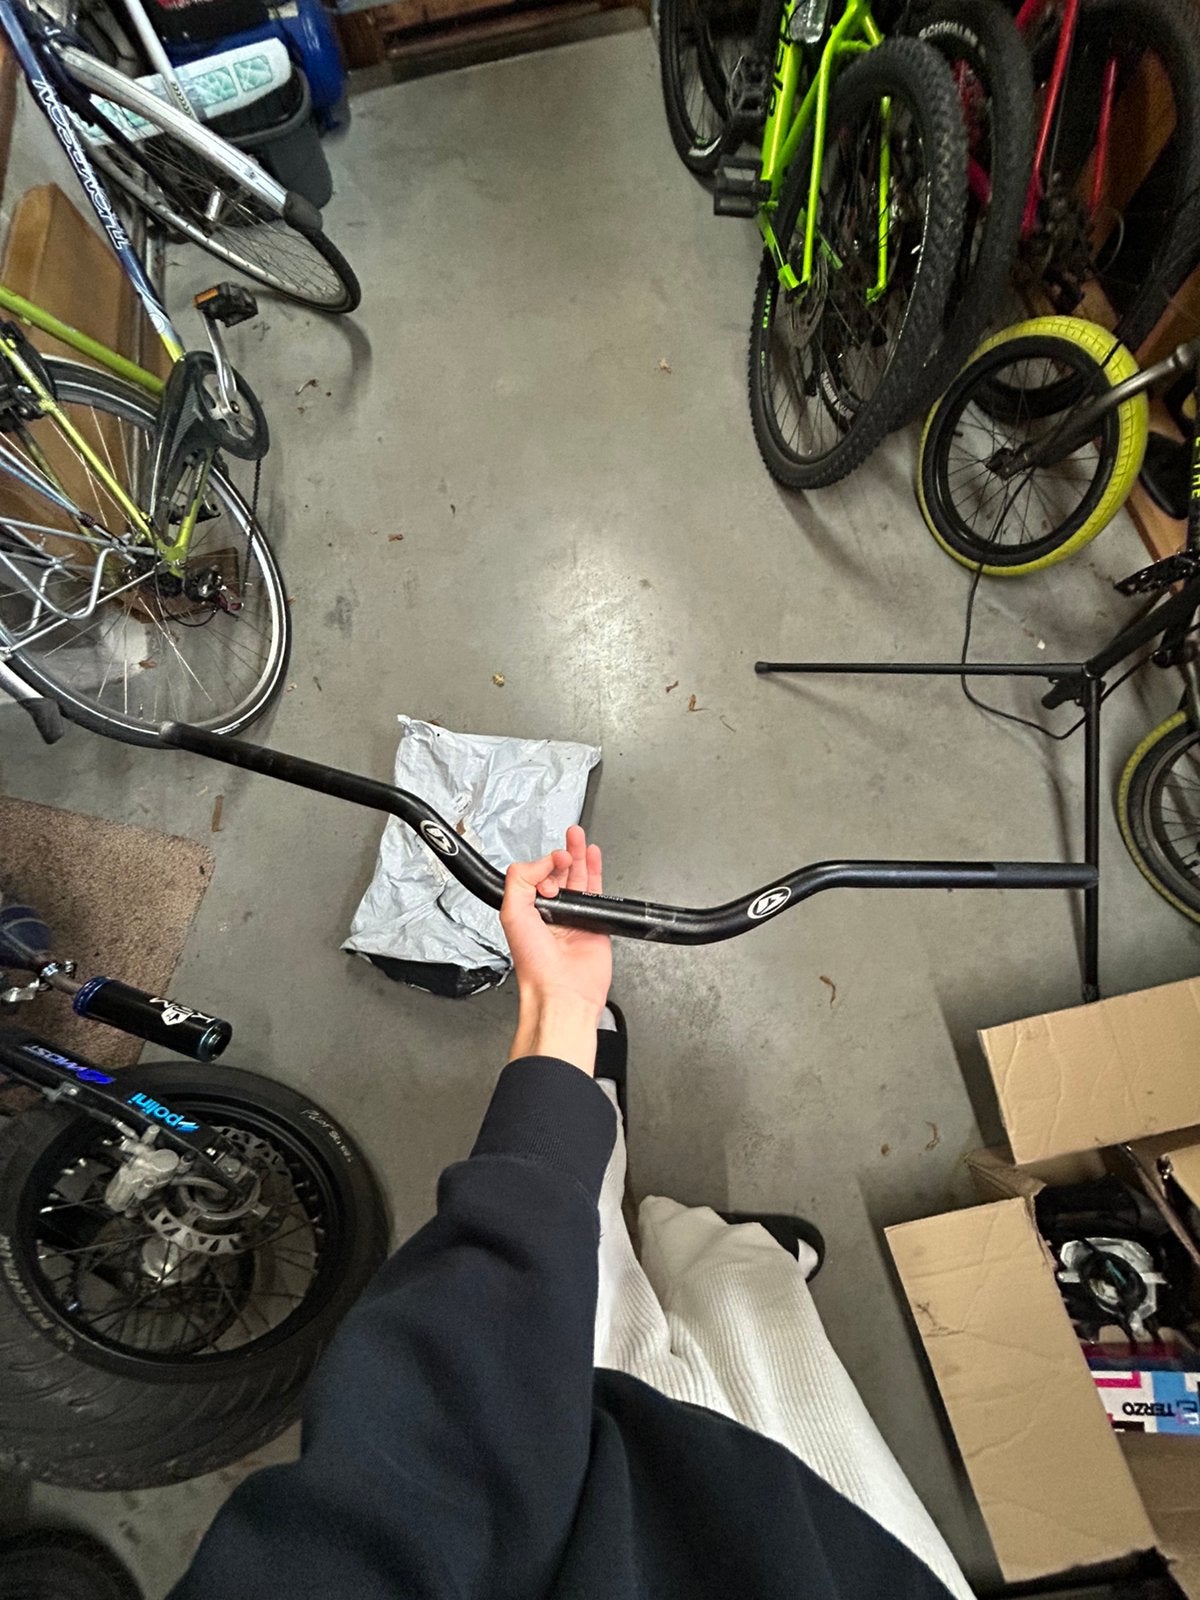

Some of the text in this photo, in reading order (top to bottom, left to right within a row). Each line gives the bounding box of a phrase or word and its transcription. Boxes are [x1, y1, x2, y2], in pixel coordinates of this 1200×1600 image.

[32, 79, 128, 249] THOMPSON
[128, 1092, 187, 1130] polini
[1122, 1401, 1175, 1417] TERZO
